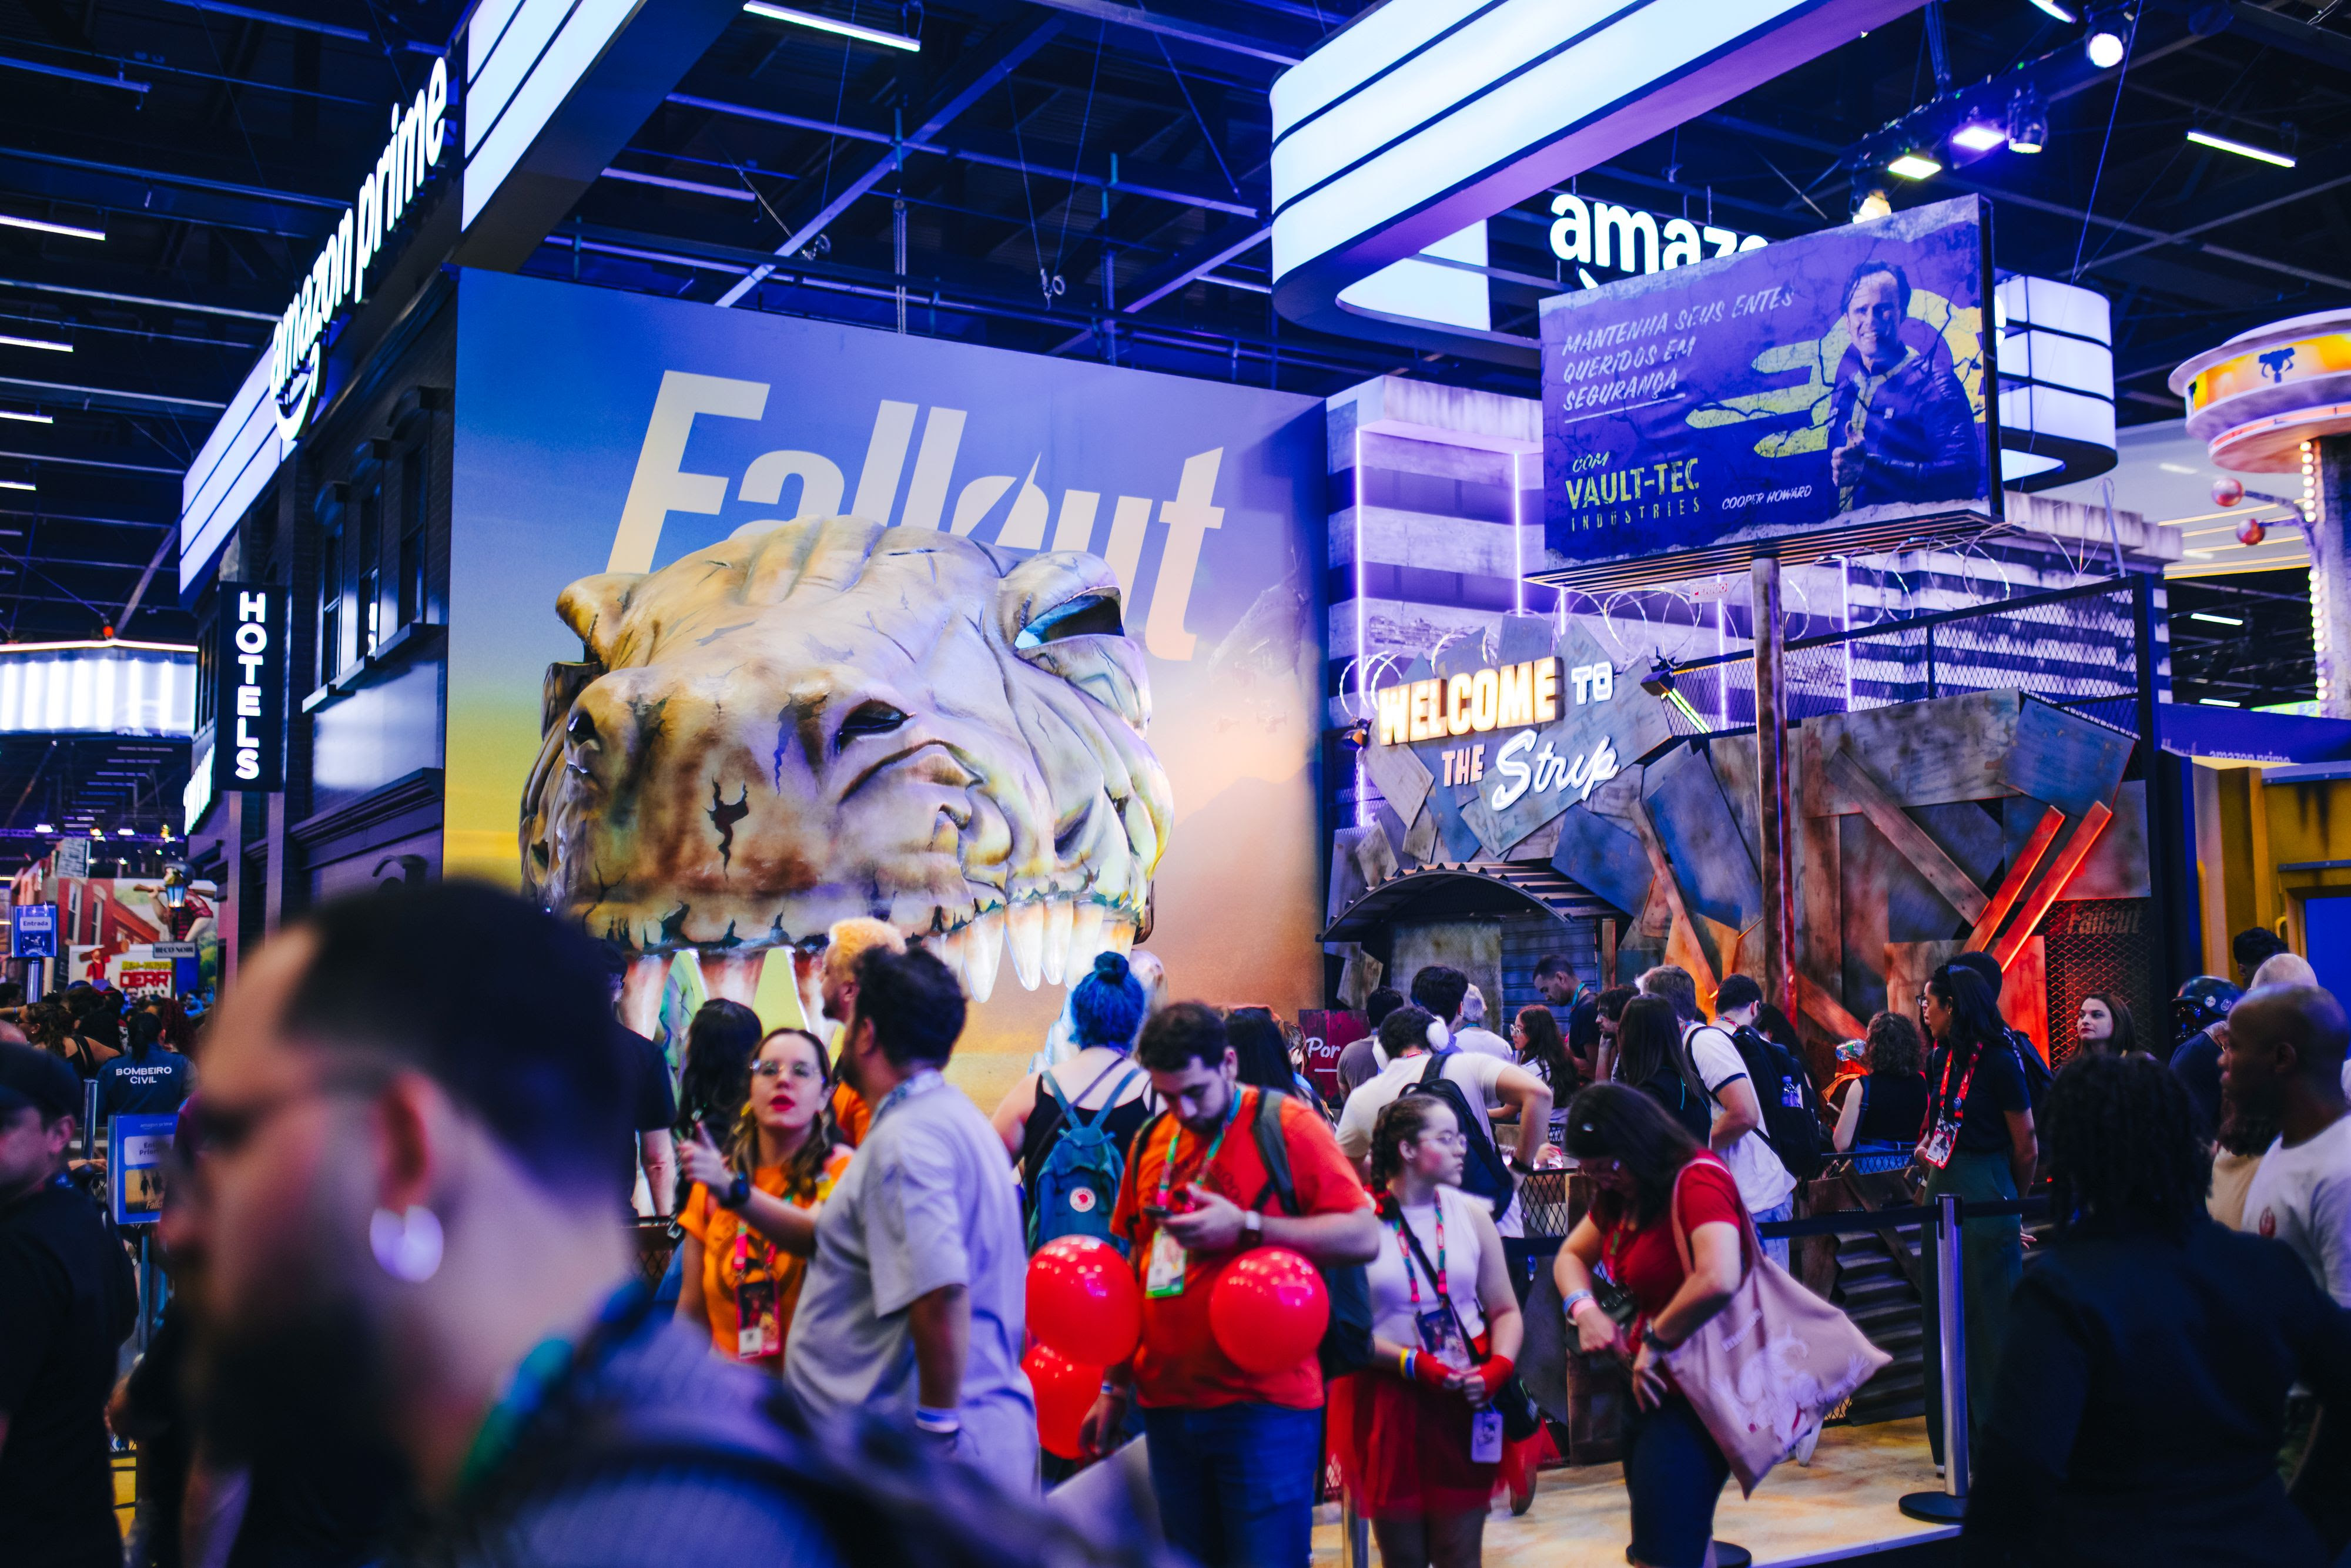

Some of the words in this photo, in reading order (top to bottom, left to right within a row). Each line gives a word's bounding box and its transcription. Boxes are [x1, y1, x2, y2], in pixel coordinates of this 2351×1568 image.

[270, 207, 353, 401] amazon
[354, 57, 447, 304] prime
[1562, 312, 1669, 356] MANTENHA
[1674, 300, 1726, 330] SEUS
[1732, 286, 1794, 319] ENTES
[1563, 344, 1658, 384] QUERIDOS
[1663, 336, 1697, 362] EM
[1563, 367, 1679, 411] SEGURANÇA
[1565, 458, 1699, 510] VAULT-TEC
[1572, 451, 1610, 473] COM
[1571, 498, 1700, 532] INDUSTRIES
[1722, 493, 1764, 510] COOPER
[1767, 485, 1812, 504] HOWARD
[235, 591, 267, 780] HOTELS
[1378, 656, 1563, 745] WELCOME
[1571, 661, 1613, 705] TO
[1442, 744, 1485, 787] THE
[1491, 729, 1620, 810] Strip
[120, 972, 172, 987] DERR
[1306, 1037, 1341, 1058] Por
[116, 1066, 172, 1076] BOMBEIRO
[130, 1076, 157, 1084] CIVIL
